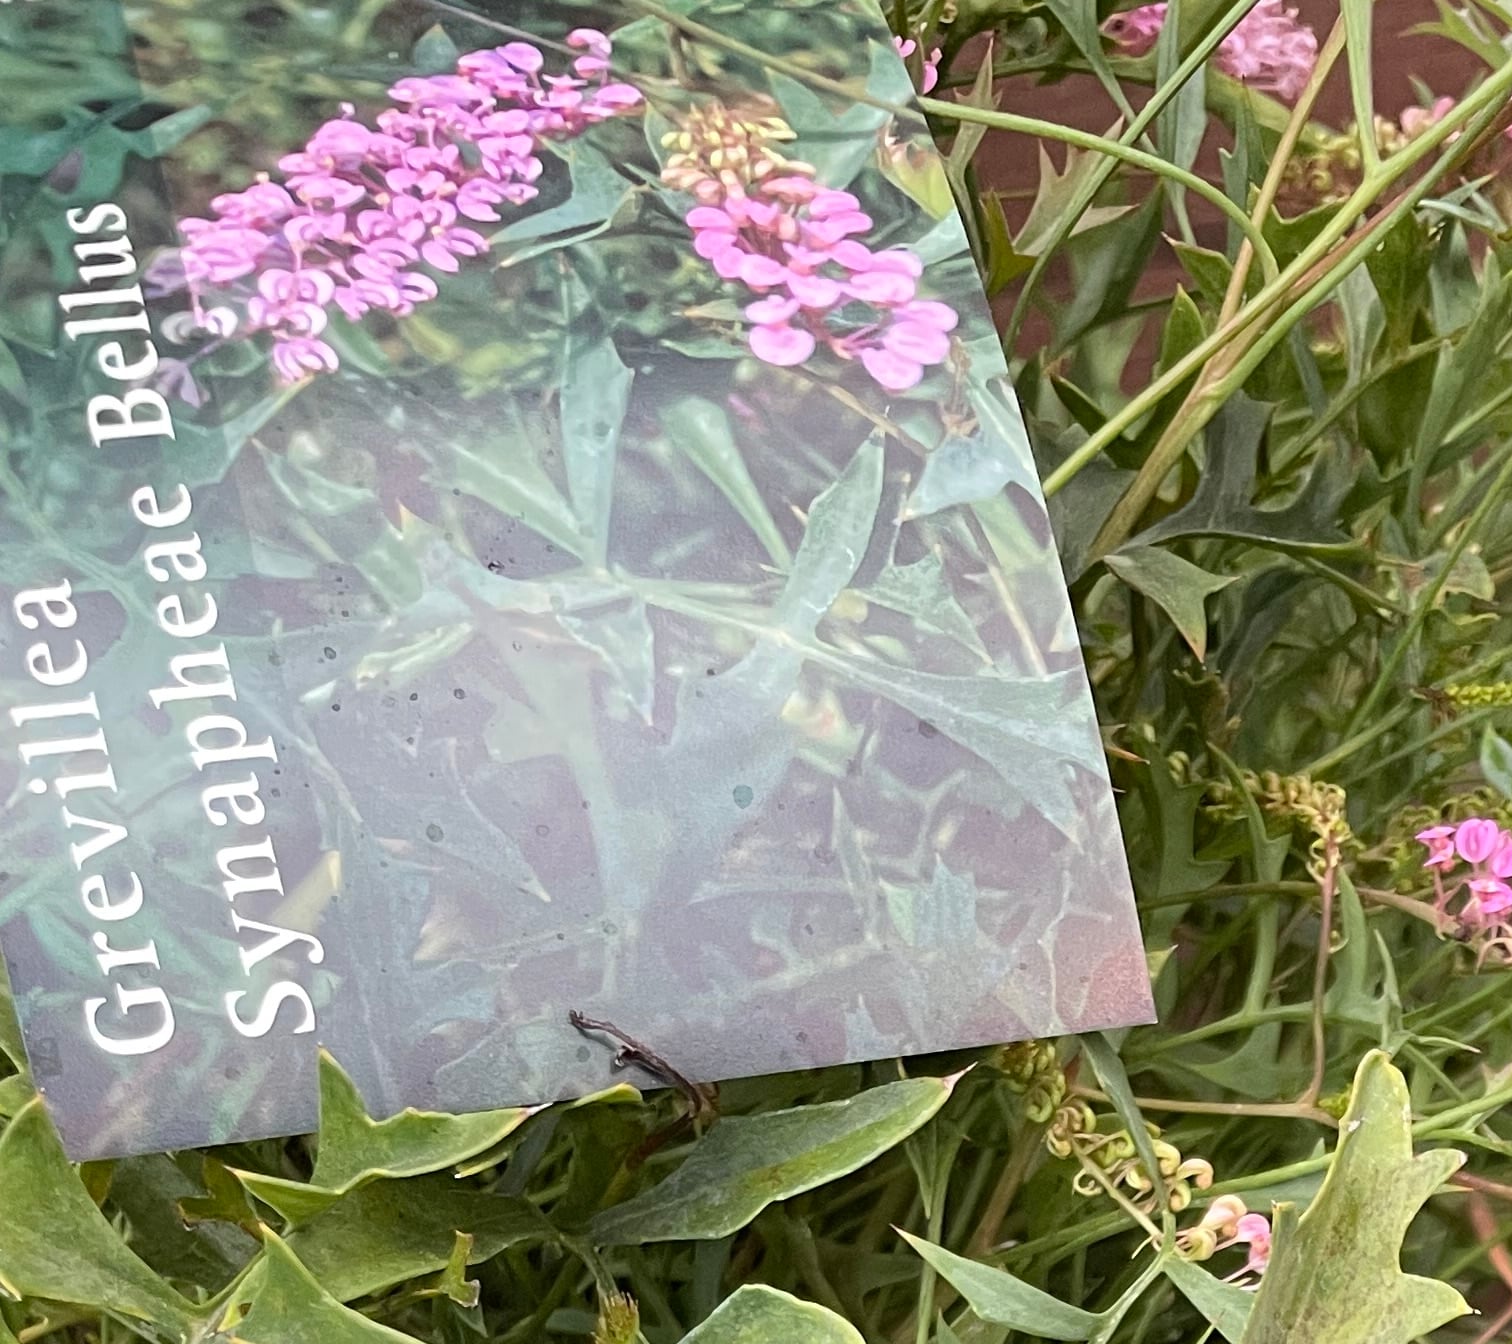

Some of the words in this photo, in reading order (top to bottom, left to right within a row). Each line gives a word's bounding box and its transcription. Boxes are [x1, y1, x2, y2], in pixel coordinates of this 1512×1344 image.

[58, 203, 176, 448] Bellus
[9, 578, 177, 1056] Grevillea
[131, 483, 325, 1038] Synapheae
